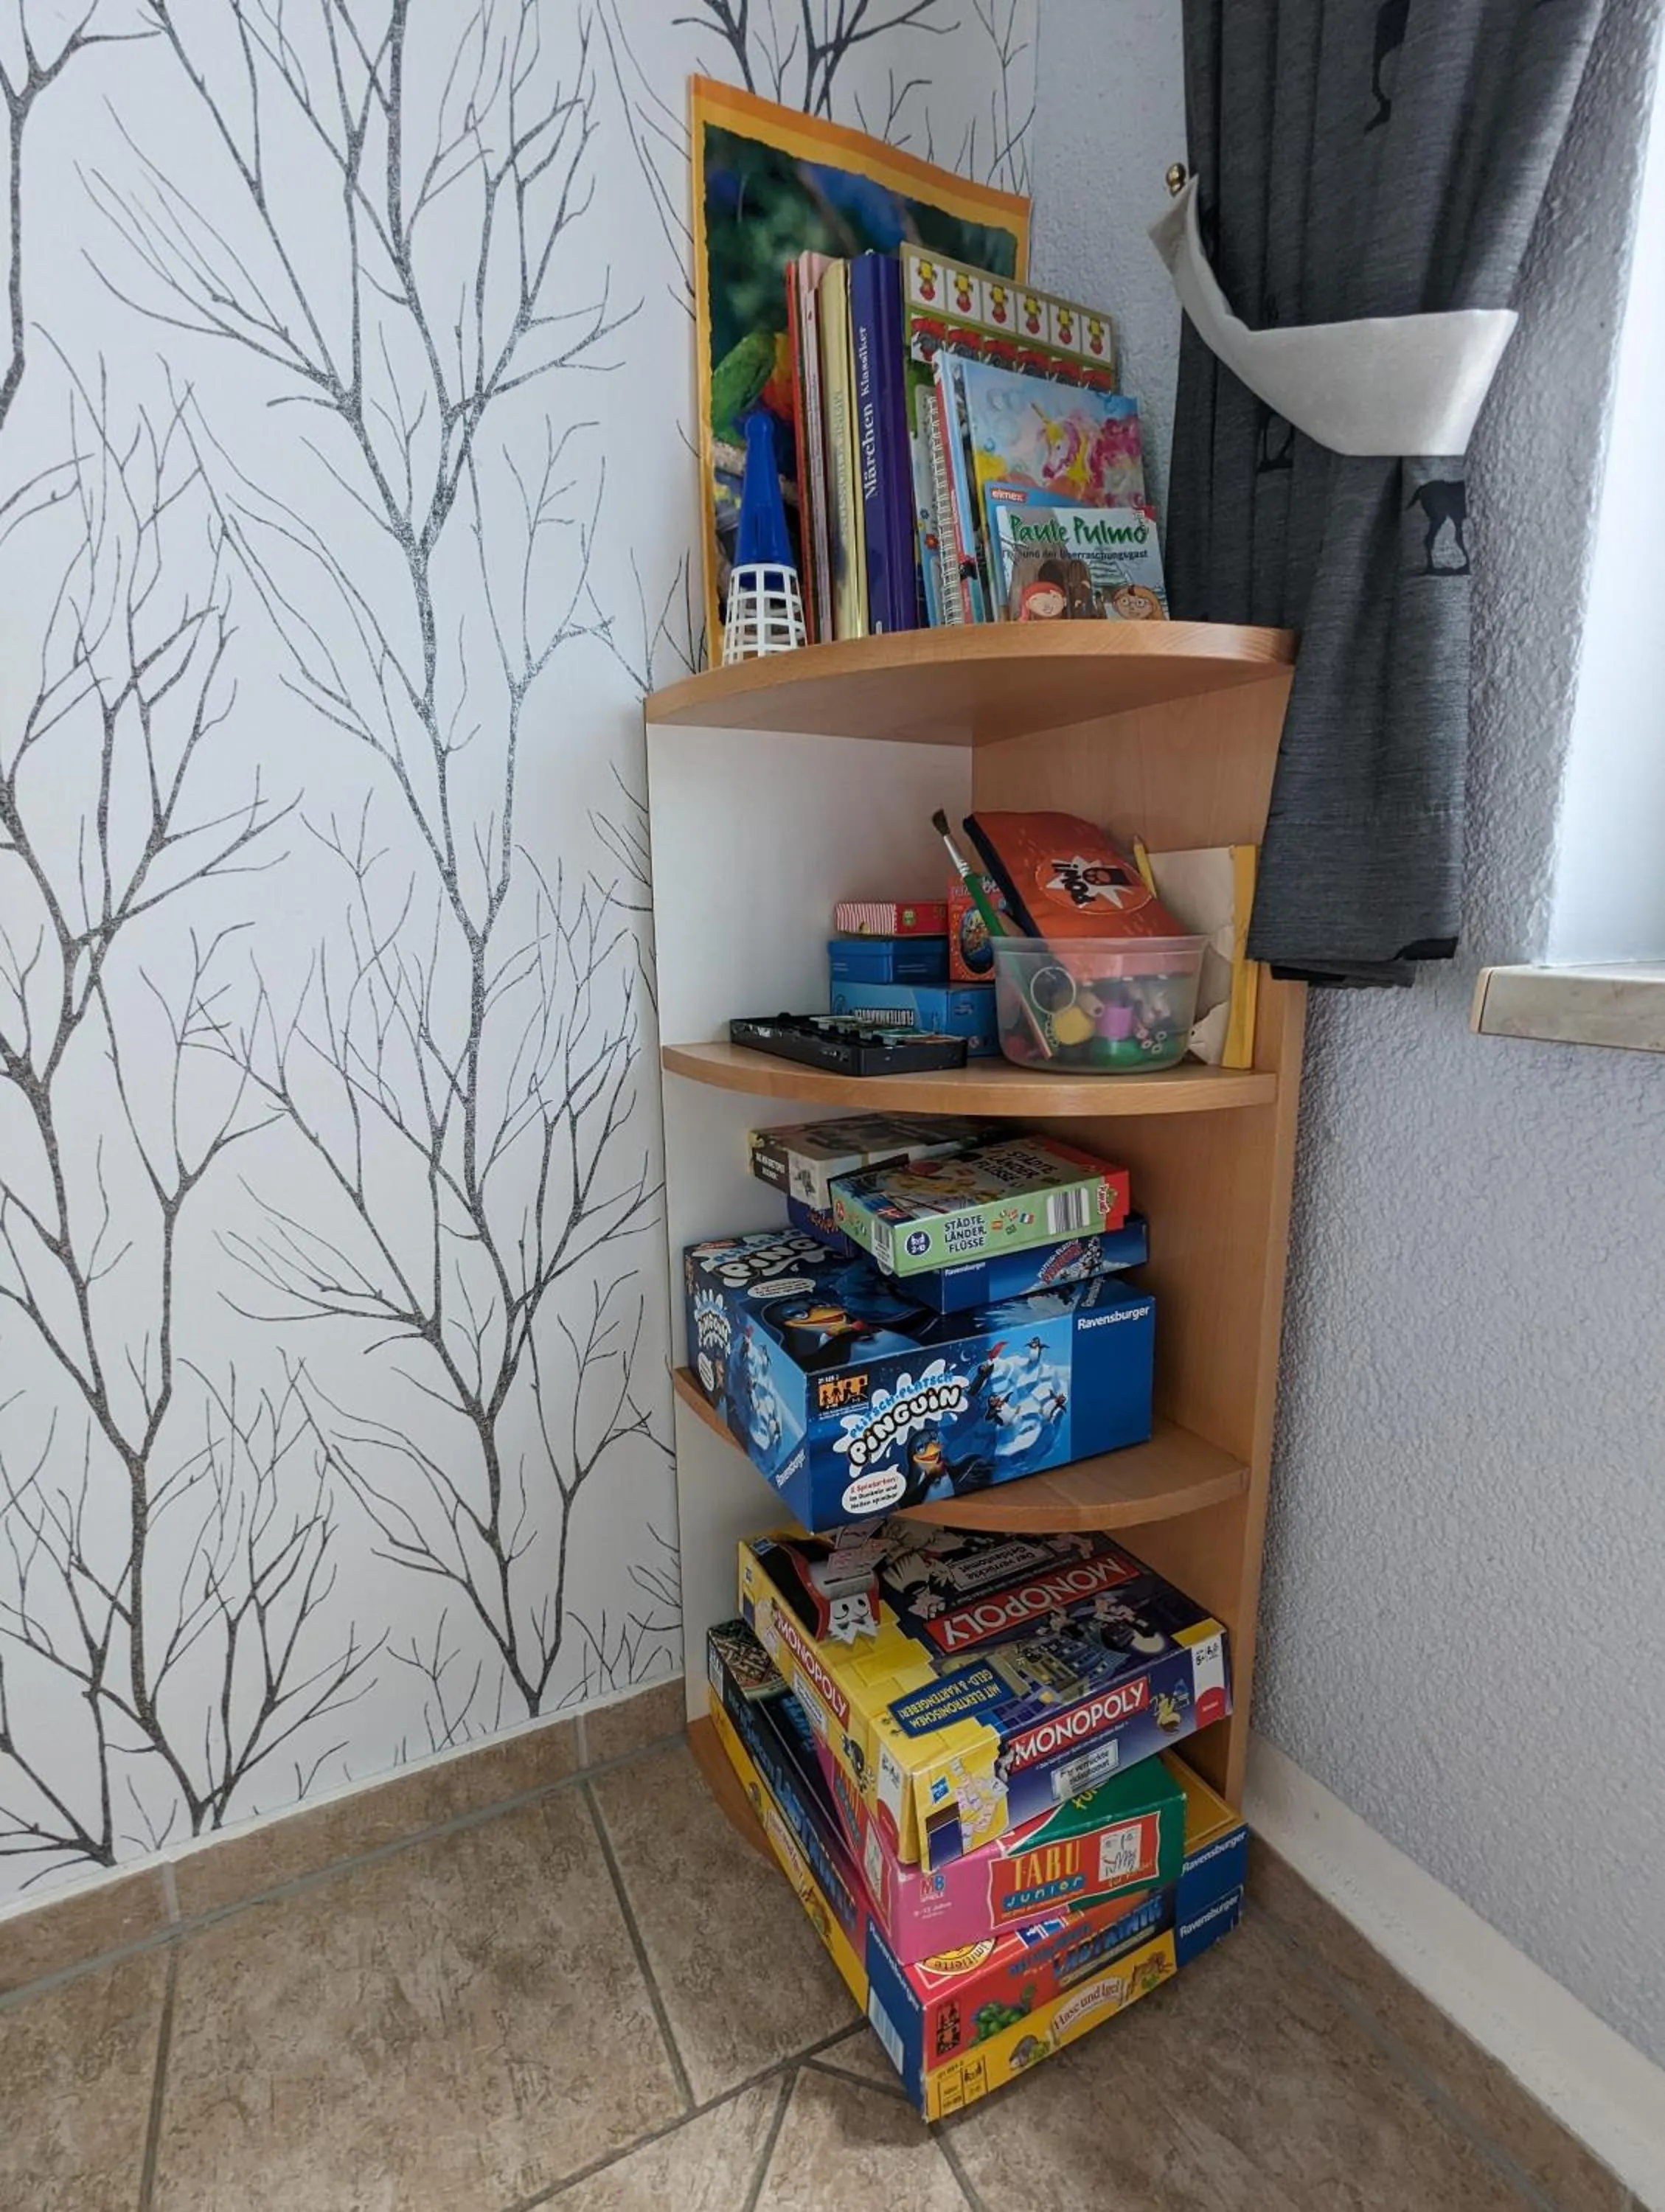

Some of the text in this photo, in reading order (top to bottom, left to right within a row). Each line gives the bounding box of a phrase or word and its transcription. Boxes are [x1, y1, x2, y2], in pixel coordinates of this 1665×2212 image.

[858, 326, 877, 501] Märchen Klassiker
[1010, 515, 1068, 543] Paule
[1073, 515, 1149, 546] Pulmo
[1077, 1306, 1150, 1331] Ravensburger
[942, 1557, 1127, 1646] MONOPOLY
[774, 1608, 847, 1718] MONOPOLY
[908, 1689, 984, 1729] ELEKTRONISCHEM
[1012, 1681, 1144, 1767] MONOPOLY
[1013, 1840, 1081, 1891] TABU
[1181, 1831, 1247, 1877] Ravensburger
[1180, 1893, 1240, 1939] Ravensburger
[1080, 1986, 1101, 2007] und
